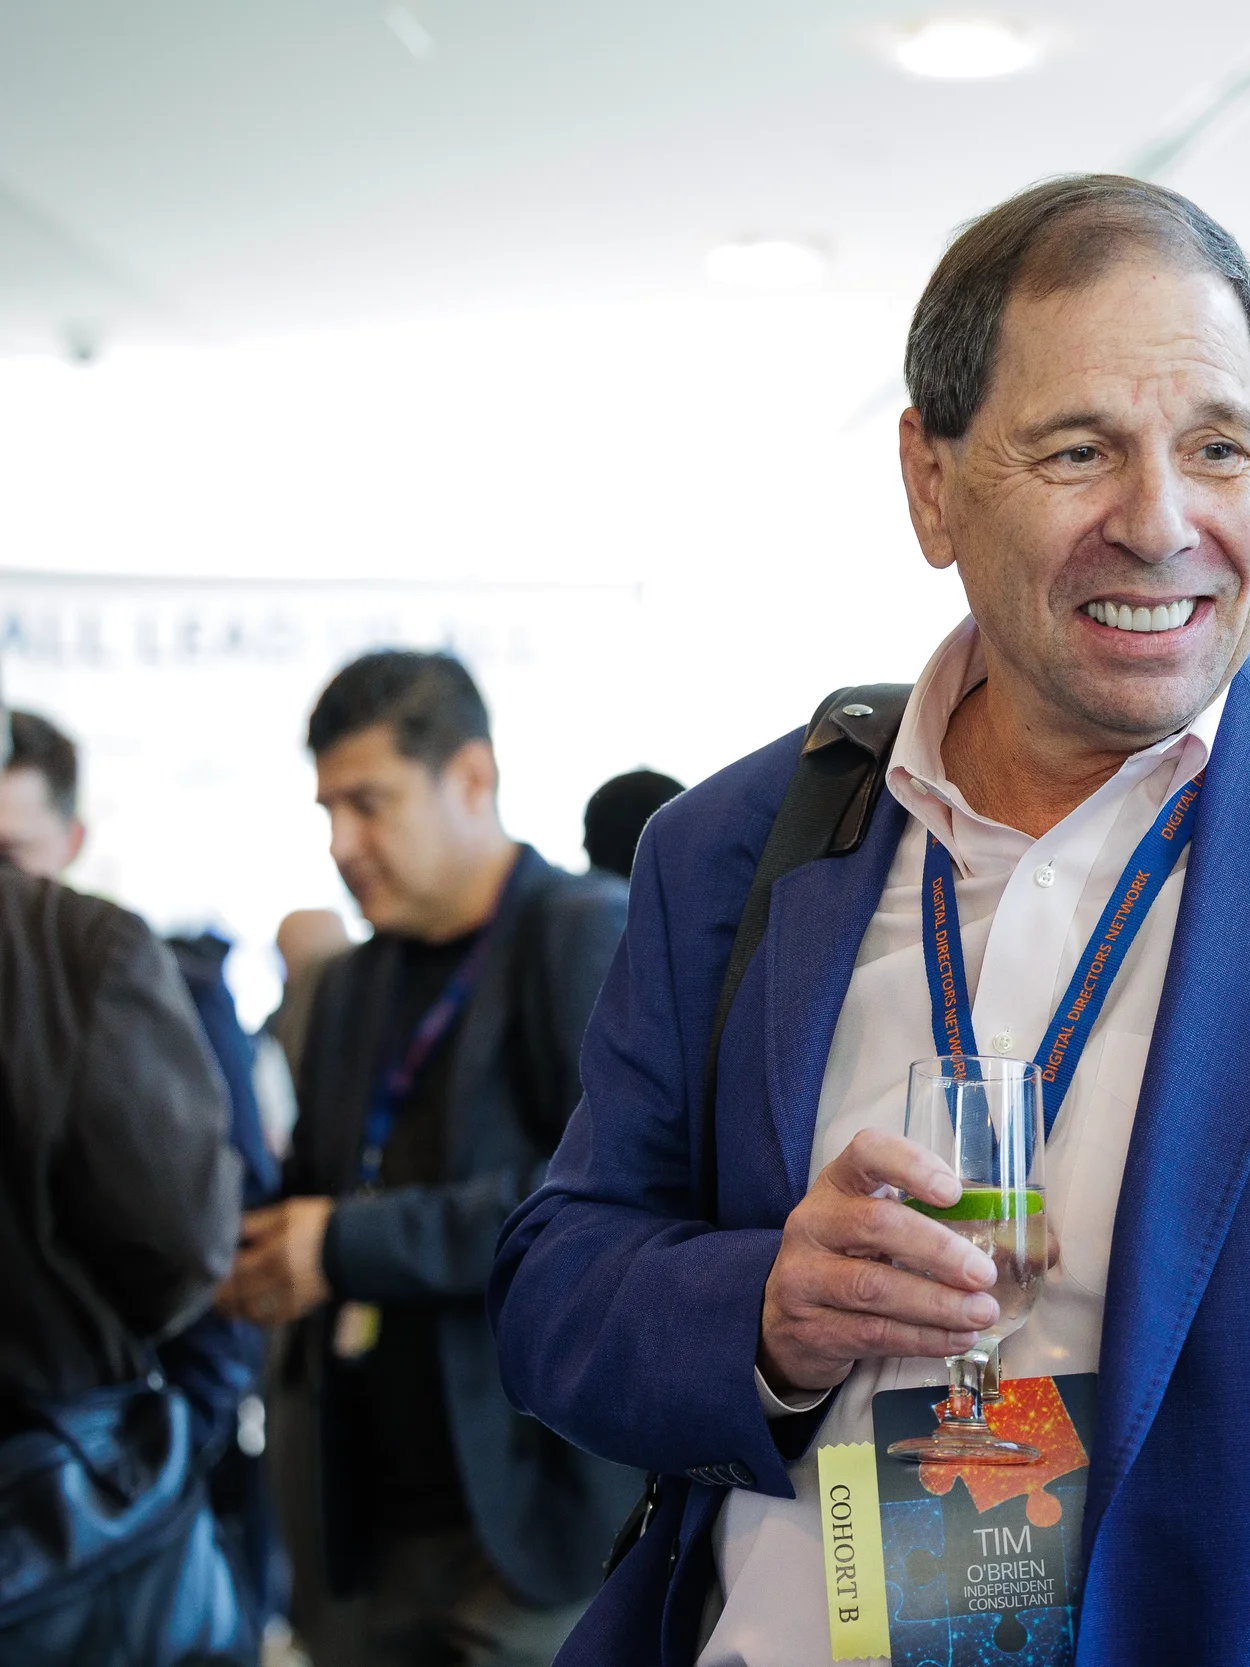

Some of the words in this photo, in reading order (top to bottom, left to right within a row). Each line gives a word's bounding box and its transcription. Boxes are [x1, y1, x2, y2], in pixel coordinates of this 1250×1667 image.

[1161, 789, 1199, 841] DIGITAL
[932, 876, 946, 930] DIGITAL
[935, 929, 957, 1008] DIRECTORS
[1041, 1025, 1075, 1083] DIGITAL
[1066, 943, 1112, 1021] DIRECTORS
[1104, 869, 1151, 942] NETWORK
[829, 1484, 859, 1600] COHORT
[973, 1525, 1033, 1557] TIM
[963, 1578, 1055, 1599] INDEPENDENT
[967, 1559, 1046, 1583] O'BRIEN
[838, 1606, 860, 1624] B
[968, 1592, 1056, 1612] CONSULTANT
